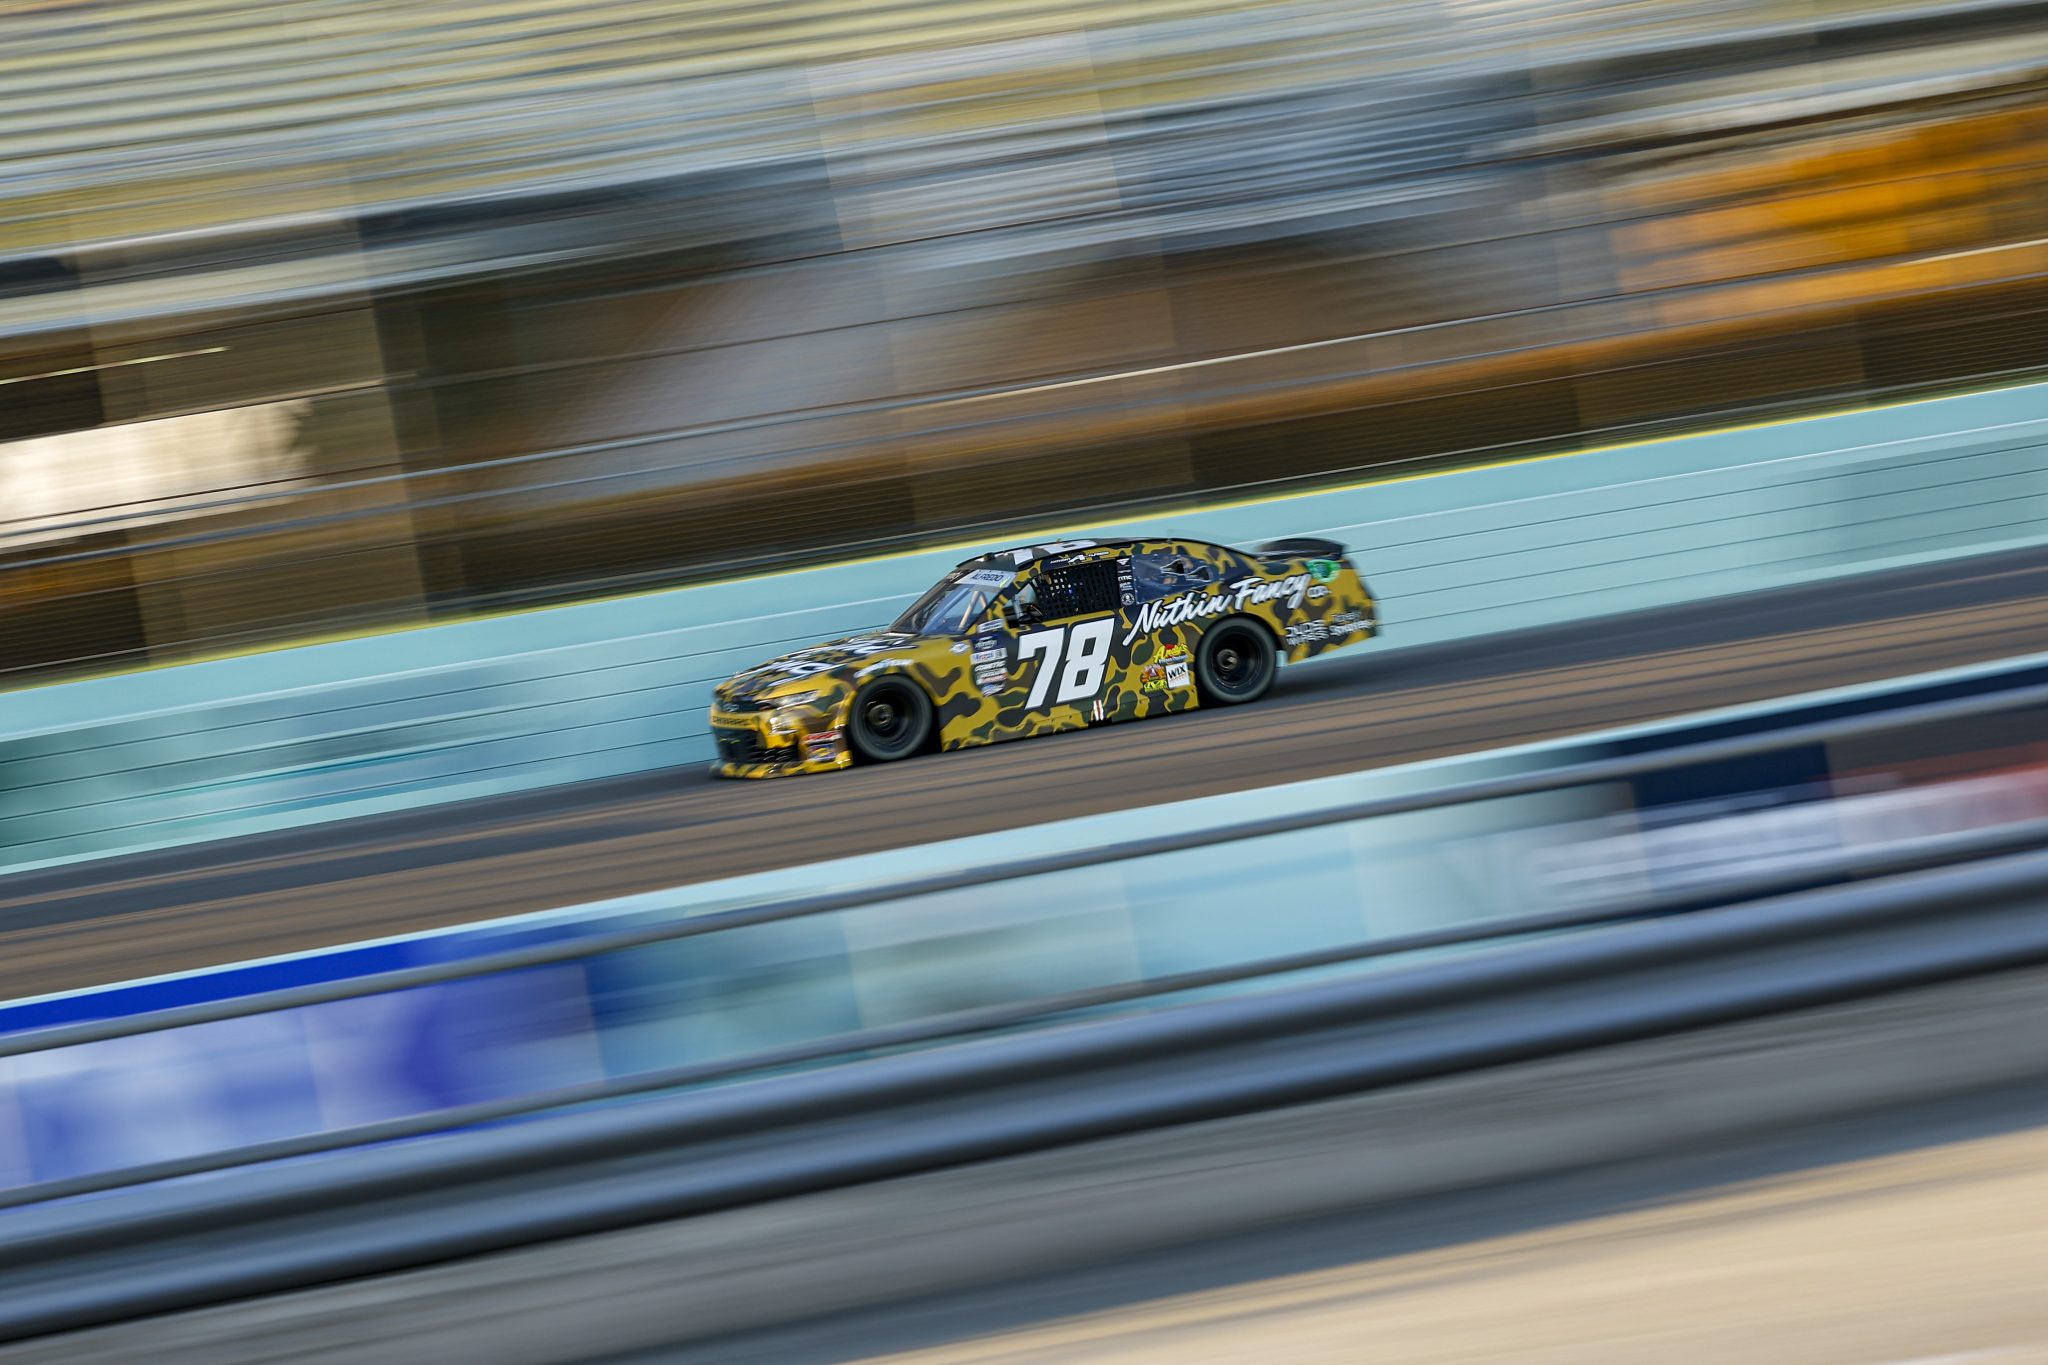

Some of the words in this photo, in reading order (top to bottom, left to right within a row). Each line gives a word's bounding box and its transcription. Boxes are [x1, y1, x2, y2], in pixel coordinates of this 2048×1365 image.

[1123, 592, 1234, 646] Nuthin
[1229, 574, 1311, 611] Fancy
[1017, 617, 1115, 710] 78
[1168, 666, 1186, 679] WIX
